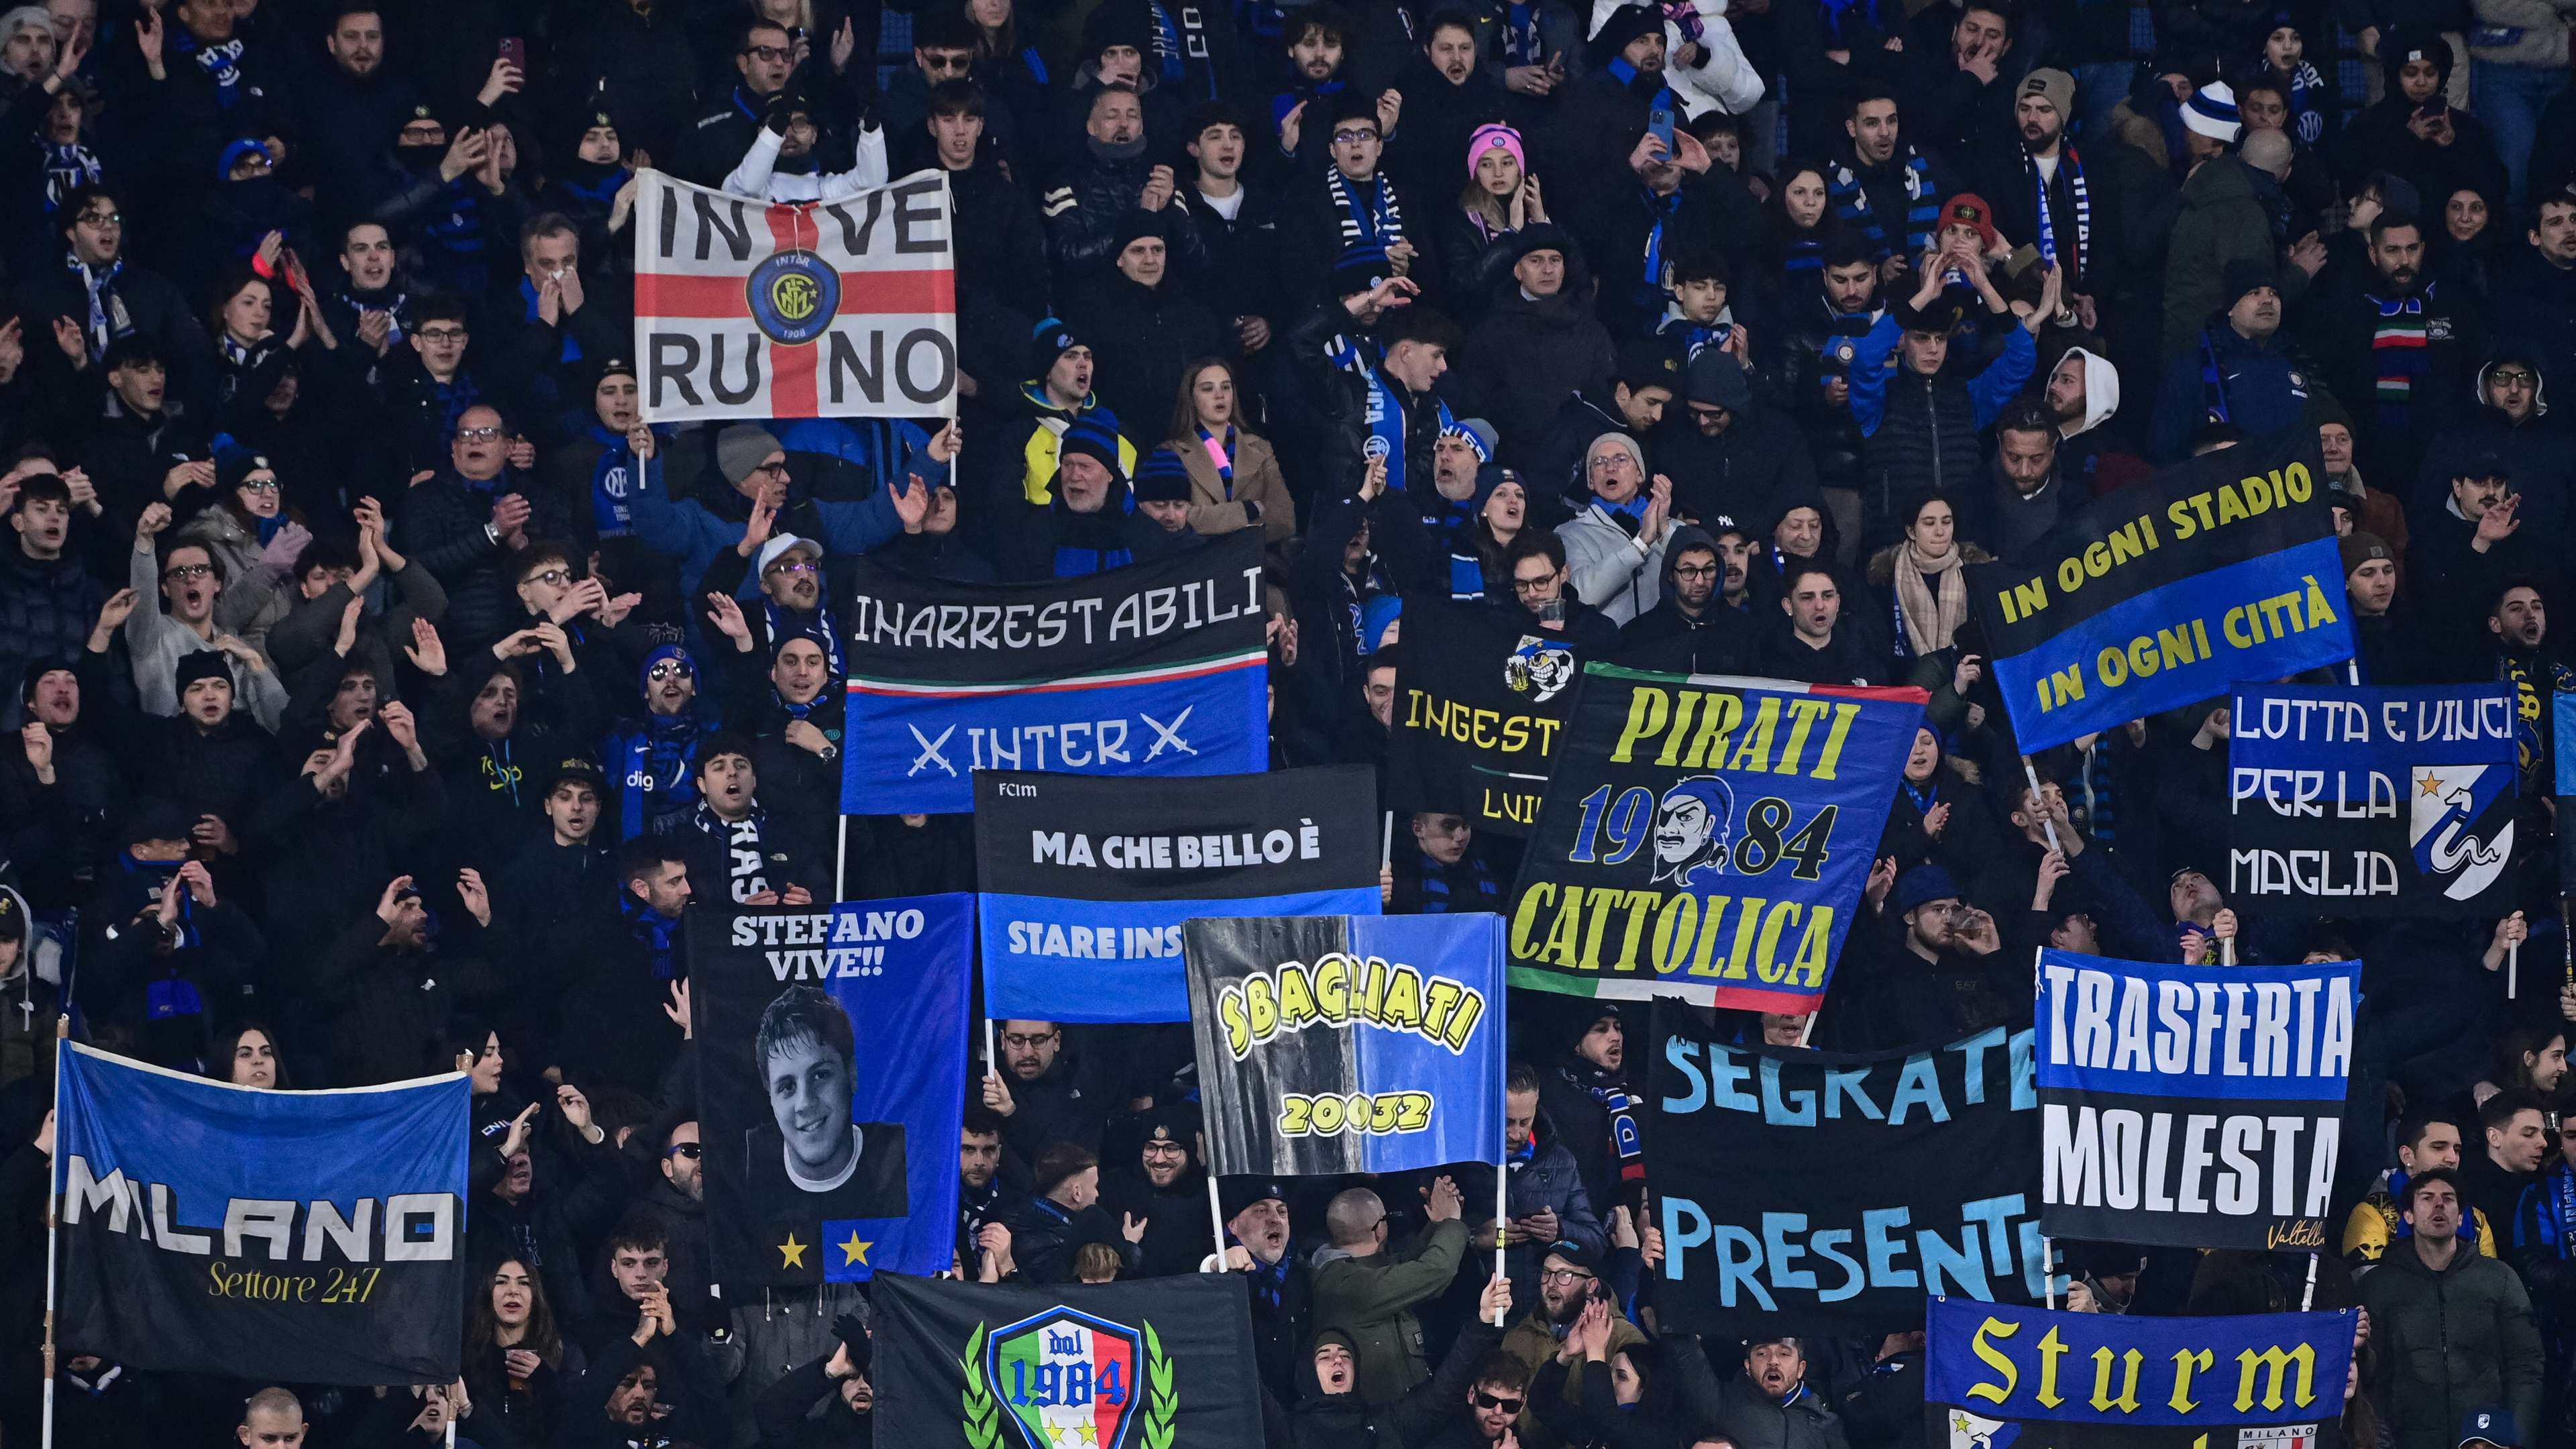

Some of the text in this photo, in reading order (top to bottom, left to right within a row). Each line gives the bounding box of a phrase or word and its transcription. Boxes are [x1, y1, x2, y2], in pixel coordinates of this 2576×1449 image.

[660, 179, 948, 261] IN VE
[783, 327, 806, 340] 1908
[649, 327, 956, 407] RU NO
[1998, 461, 2312, 625] IN OGNI STADIO
[855, 566, 1262, 649] INARRESTABILI
[2035, 574, 2337, 712] IN OGNI CITTÀ
[968, 719, 1130, 772] INTER
[1610, 686, 1861, 780] PIRATI
[2236, 696, 2513, 743] LOTTA E VINCI
[627, 769, 653, 792] dig
[2232, 767, 2396, 818] PER LA
[1033, 818, 1320, 869] MA CHE BELLO È
[1569, 784, 1838, 881] 19 84
[2231, 849, 2399, 896] MAGLIA
[732, 909, 924, 947] STEFANO
[1008, 921, 1182, 960] STARE INS
[1510, 881, 1834, 988] CATTOLICA
[765, 946, 884, 981] VIVE!!
[1219, 954, 1485, 1060] SBAGLIATI
[2045, 965, 2353, 1079] TRASFERTA
[1663, 1027, 2037, 1127] SEGRATE
[1278, 1091, 1434, 1138] 20032
[2043, 1104, 2340, 1218] MOLESTA
[63, 1154, 456, 1262] MILANO
[209, 1260, 381, 1303] Settore 247
[1662, 1193, 2072, 1311] PRESENTE
[1049, 1329, 1083, 1355] dal
[1966, 1316, 2317, 1413] Sturm
[1011, 1356, 1126, 1408] 1984
[2243, 1426, 2314, 1442] MILANO
